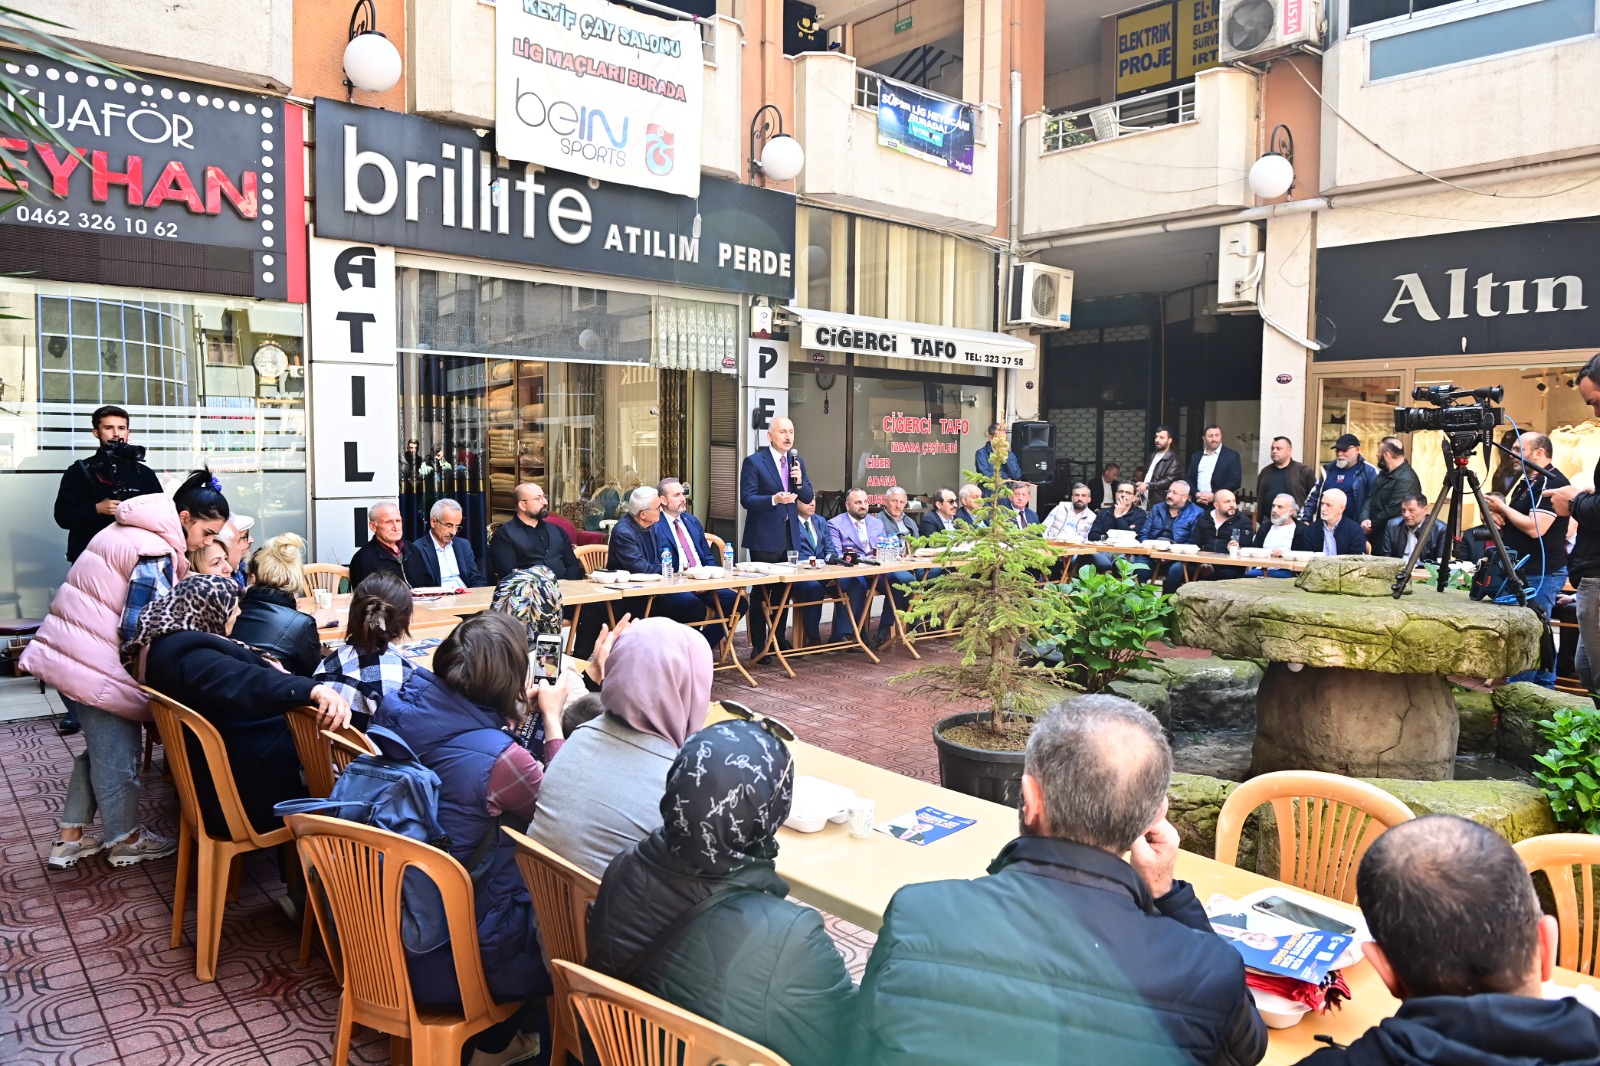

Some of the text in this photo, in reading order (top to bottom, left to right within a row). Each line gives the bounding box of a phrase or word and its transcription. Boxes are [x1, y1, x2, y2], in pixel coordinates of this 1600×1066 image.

[579, 14, 616, 41] ÇAY
[618, 26, 681, 58] SALONU
[546, 48, 626, 83] MAÇLARI
[627, 69, 687, 103] BURADA
[1119, 47, 1171, 78] PROJE
[560, 138, 626, 167] SPORTS
[344, 124, 592, 244] brillife
[16, 206, 178, 238] 0462 326 10 62
[603, 224, 791, 278] ATILIM PERDE
[1382, 267, 1589, 324] Altın
[911, 337, 957, 359] TAFO
[964, 351, 982, 362] TEL:
[984, 353, 999, 364] 323
[1001, 355, 1012, 366] 37
[1013, 356, 1024, 367] 58
[882, 411, 970, 435] CİĞERCİ TAFO
[866, 454, 891, 468] CİĞER
[866, 475, 897, 487] ADANA
